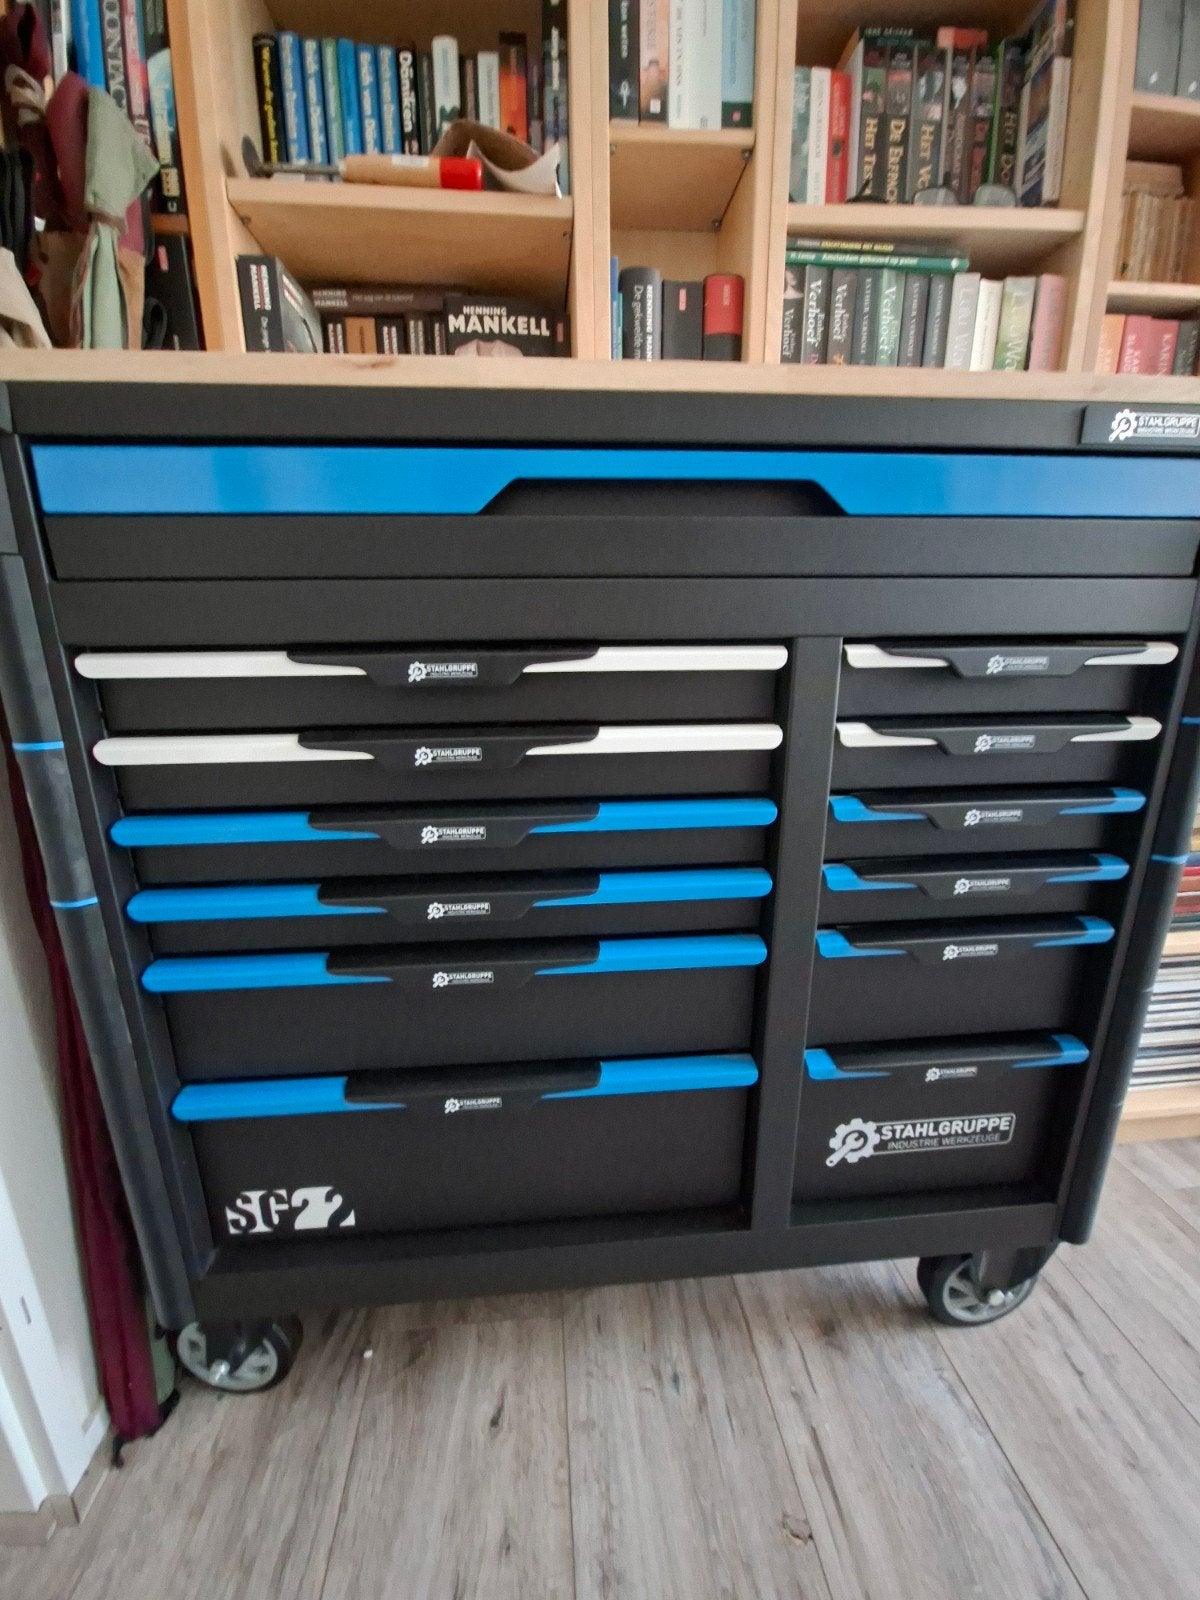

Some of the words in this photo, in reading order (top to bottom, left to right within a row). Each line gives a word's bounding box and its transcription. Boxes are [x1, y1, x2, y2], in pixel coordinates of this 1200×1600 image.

[634, 284, 644, 300] De
[462, 305, 507, 315] HENNING
[806, 279, 823, 348] Verhoef
[833, 283, 848, 343] Verhoef
[448, 313, 550, 337] MANKELL
[879, 286, 897, 354] Verhoef
[782, 308, 794, 358] Verhoef
[1138, 415, 1198, 428] STAHLGRUPPE
[426, 664, 476, 672] STAHLGRUPPE
[432, 748, 480, 756] STAHLGRUPPE
[438, 827, 484, 835] STAHLGRUPPE
[444, 903, 489, 911] STAHLGRUPPE
[449, 972, 492, 980] STAHLGRUPPE
[459, 1098, 501, 1106] STAHLGRUPPE
[880, 1116, 1012, 1140] STAHLGRUPPE
[887, 1137, 940, 1150] INDUSTRIE
[942, 1132, 1001, 1146] WERKZEUGE
